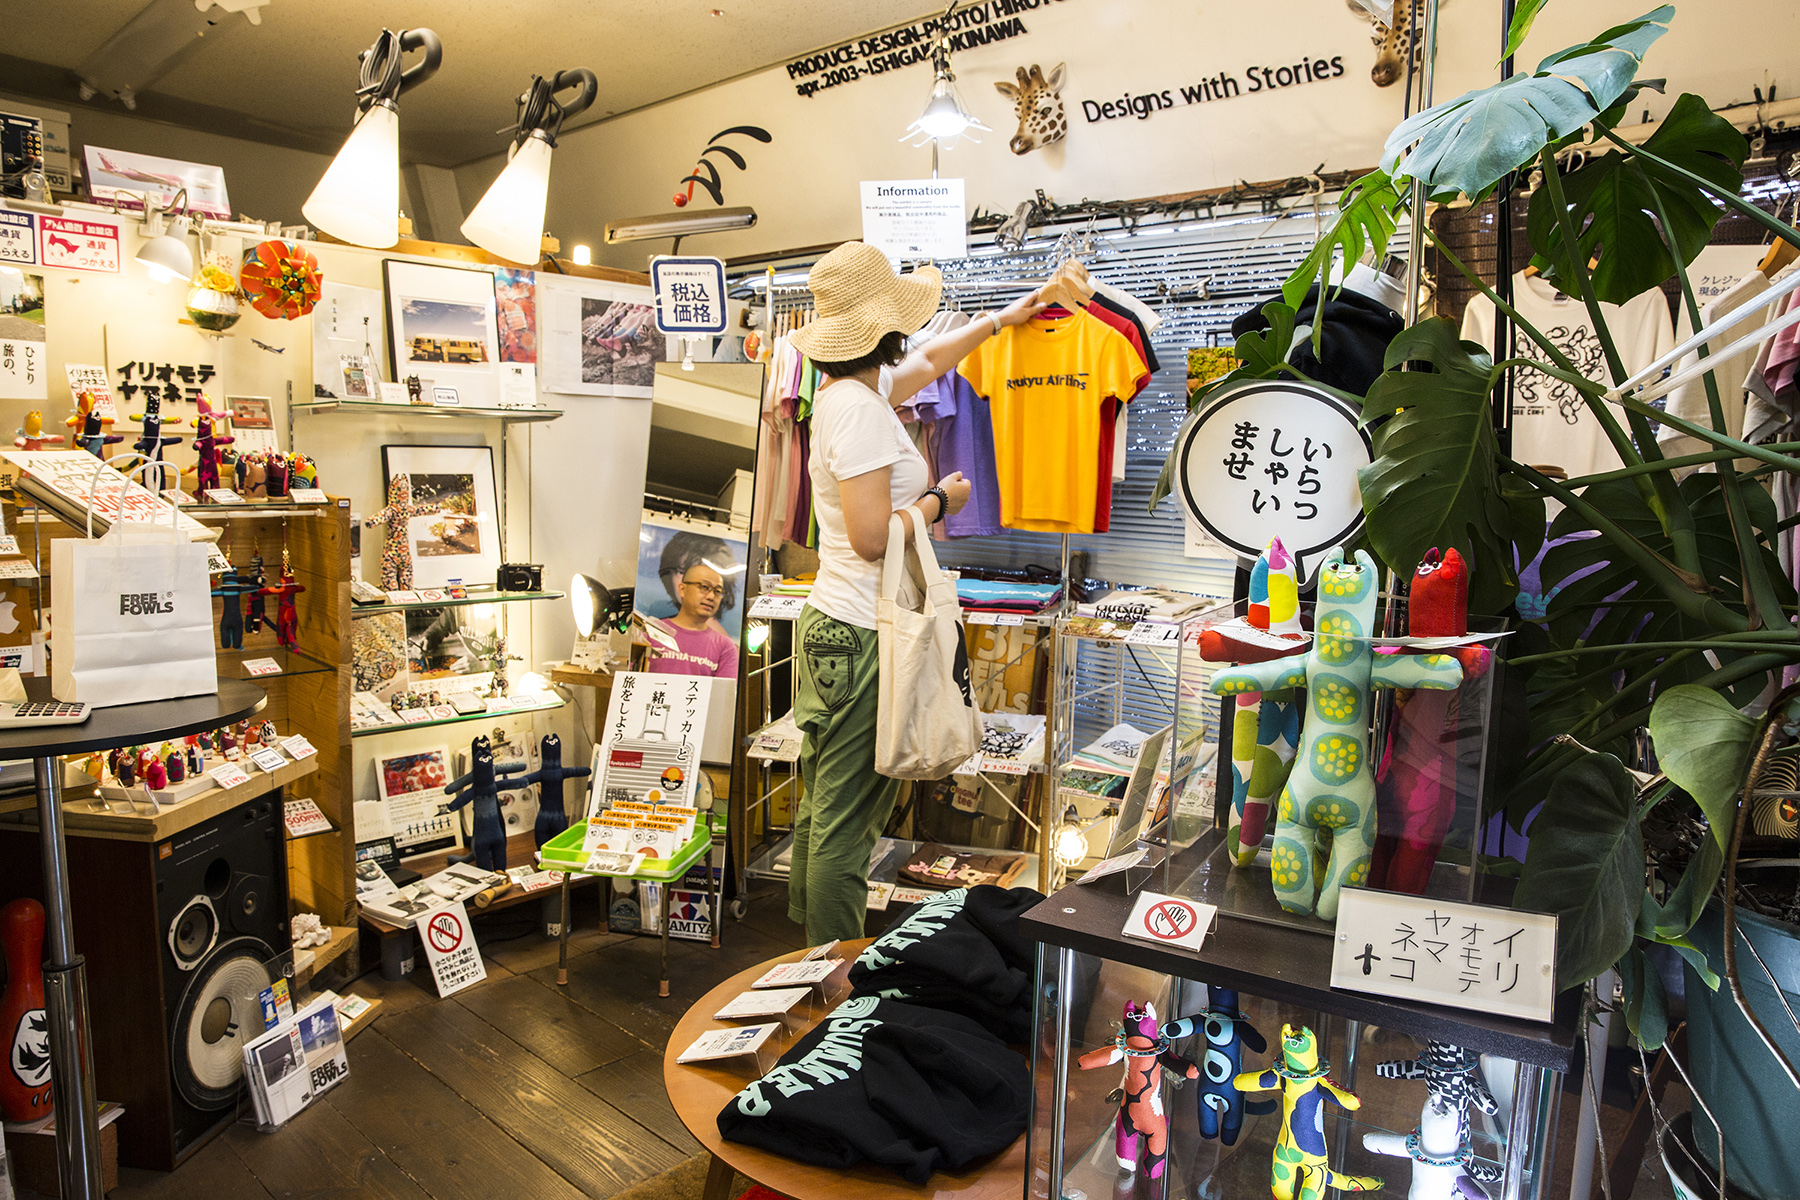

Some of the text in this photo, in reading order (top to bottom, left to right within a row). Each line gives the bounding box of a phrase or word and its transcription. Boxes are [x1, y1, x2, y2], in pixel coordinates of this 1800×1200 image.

[1082, 56, 1345, 123] Designs with Stories
[877, 186, 949, 197] Information
[0, 247, 29, 258] らえる
[87, 240, 106, 250] 通貨
[79, 257, 115, 268] つかえる
[671, 283, 709, 302] 税込
[25, 346, 35, 385] ひとり
[117, 361, 216, 384] イリオモテ
[1223, 421, 1260, 481] ませ
[1252, 428, 1295, 515] しゃい
[1294, 437, 1333, 521] いらっ
[120, 591, 159, 606] FREE
[120, 600, 174, 616] FOWLS
[614, 675, 636, 742] 旅をしよう
[649, 681, 668, 717] 一緒に
[675, 680, 699, 762] ステッカーと
[605, 788, 628, 797] FREE
[957, 796, 973, 808] tee
[1390, 923, 1420, 982] ネコ
[1458, 922, 1484, 993] オモテ
[1492, 928, 1526, 993] イリ
[310, 1059, 335, 1080] FREE
[312, 1062, 348, 1091] FOWLS
